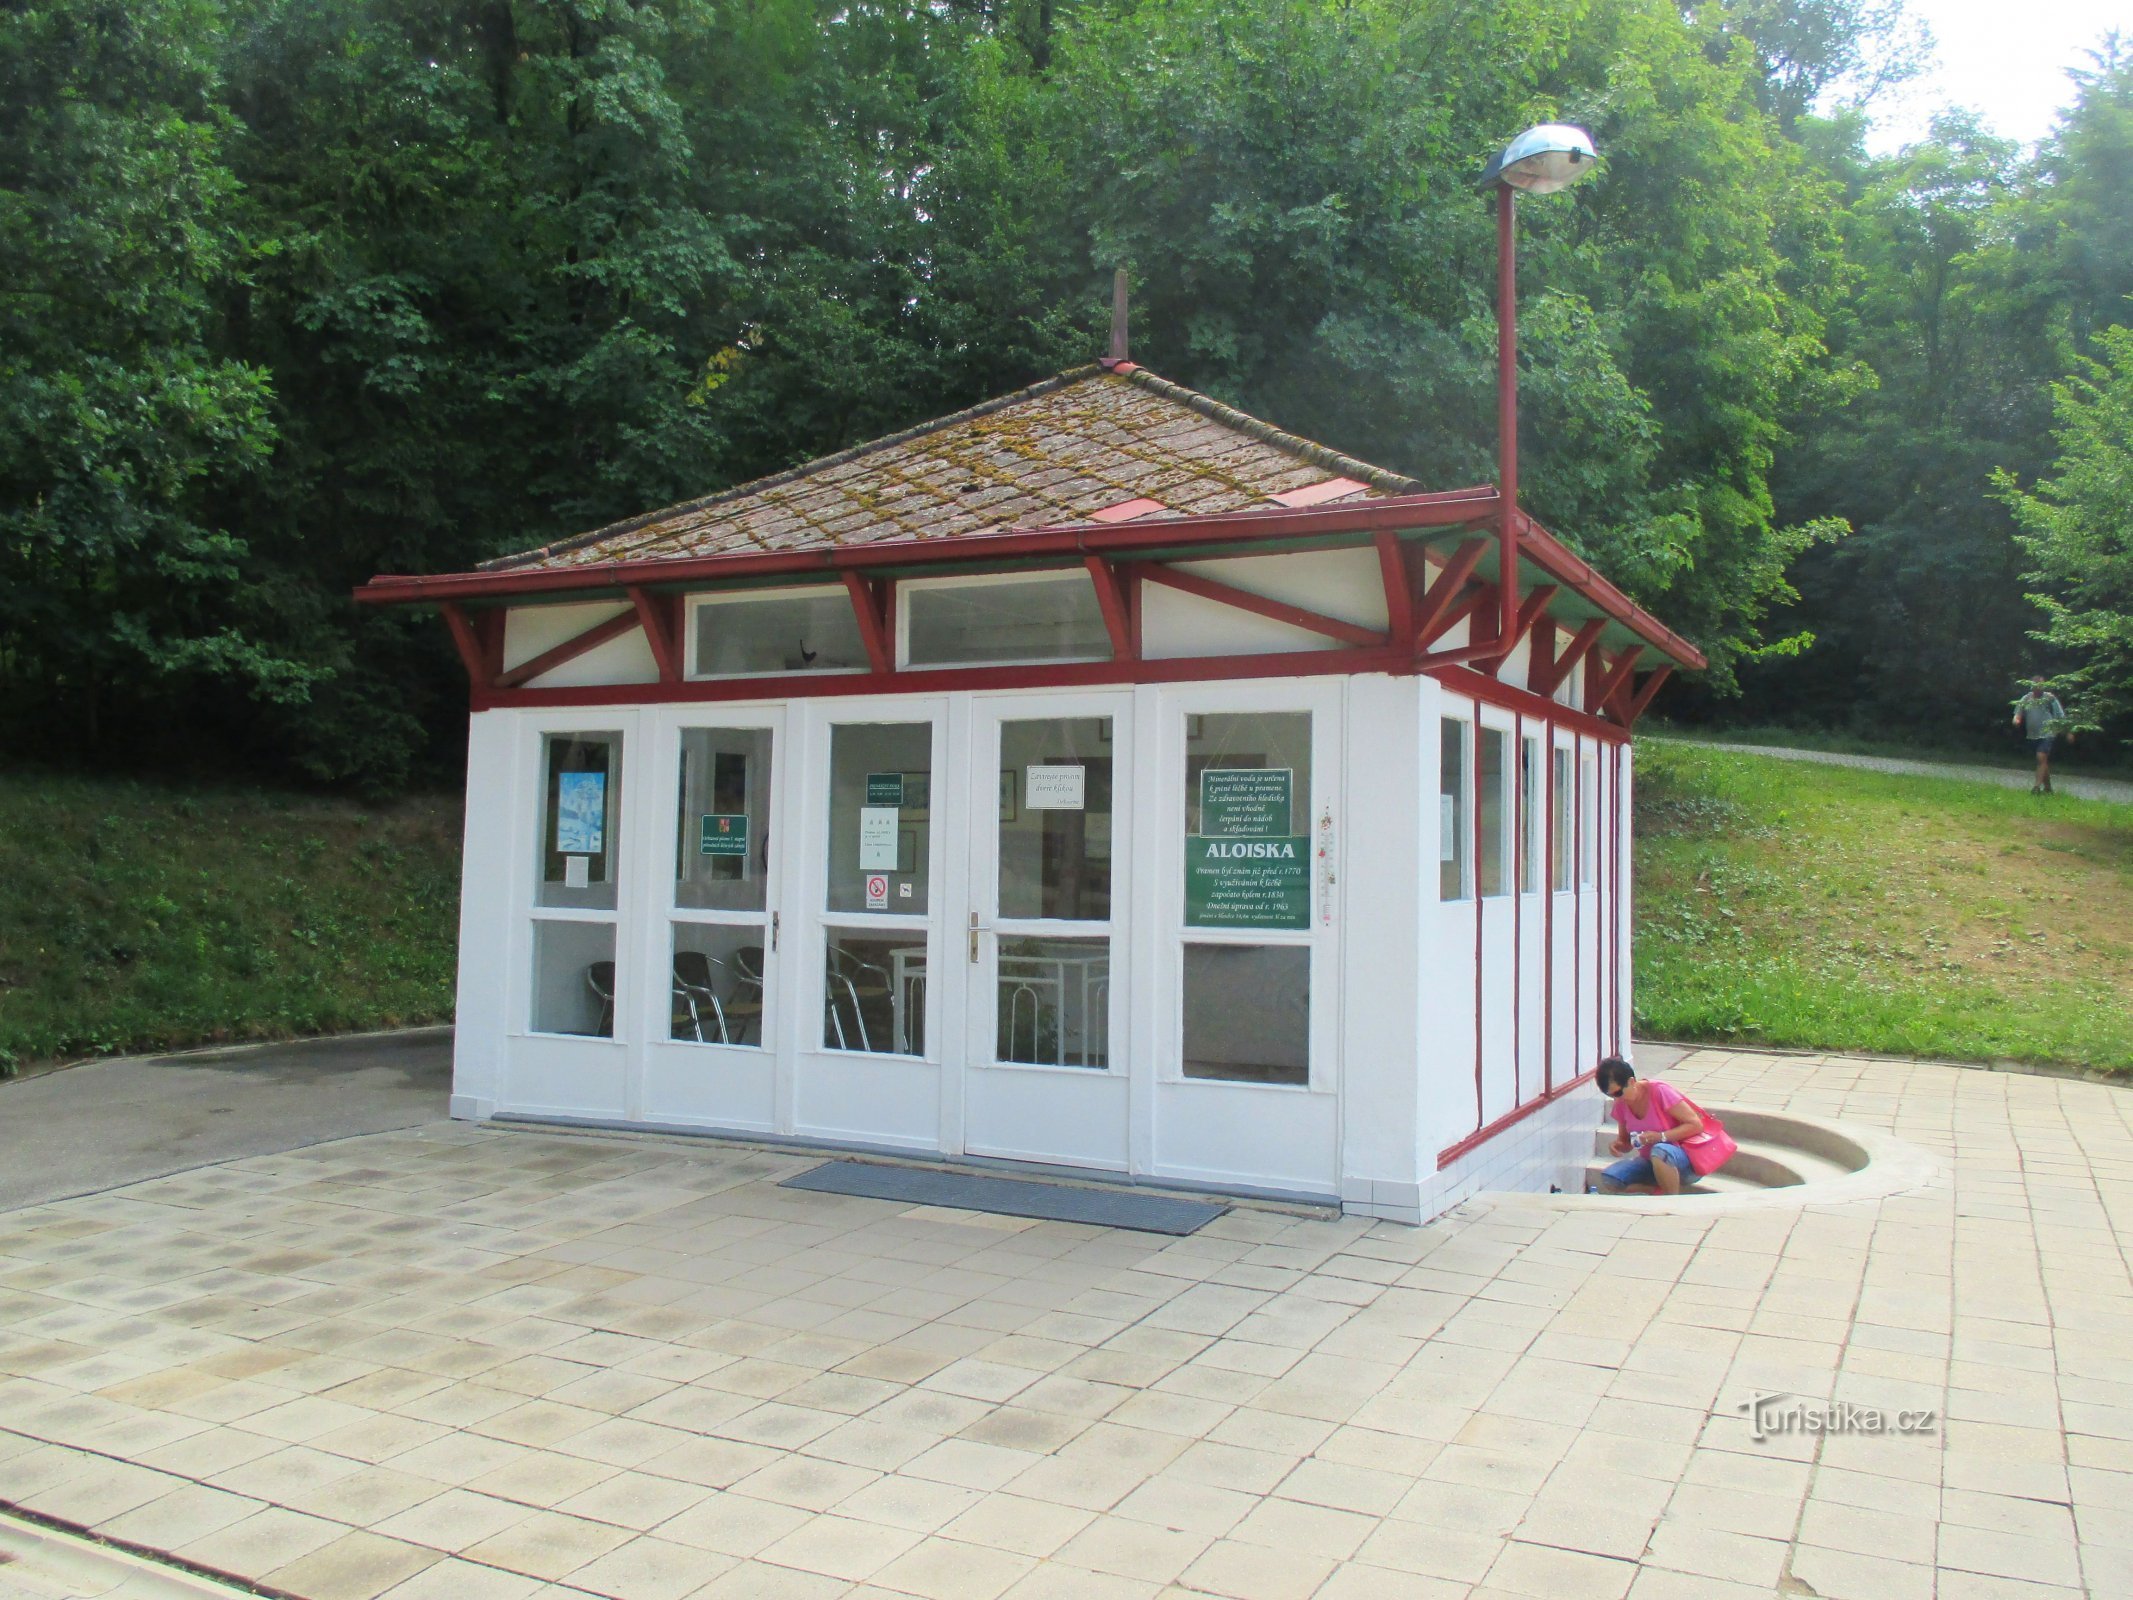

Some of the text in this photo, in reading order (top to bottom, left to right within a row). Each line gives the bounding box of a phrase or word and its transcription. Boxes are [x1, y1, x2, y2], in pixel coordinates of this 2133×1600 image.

[1208, 774, 1239, 782] Minerální
[1240, 774, 1254, 782] voda
[1208, 794, 1217, 802] Ze
[1218, 794, 1257, 802] zdravotního
[1243, 814, 1252, 822] do
[1205, 843, 1296, 858] ALOISKA
[1196, 867, 1220, 876] Pramen
[1221, 867, 1232, 876] byl
[1232, 867, 1251, 875] znám
[1211, 890, 1240, 899] započato
[1241, 890, 1261, 899] kolem
[1231, 902, 1254, 911] úprava
[1255, 901, 1264, 910] od
